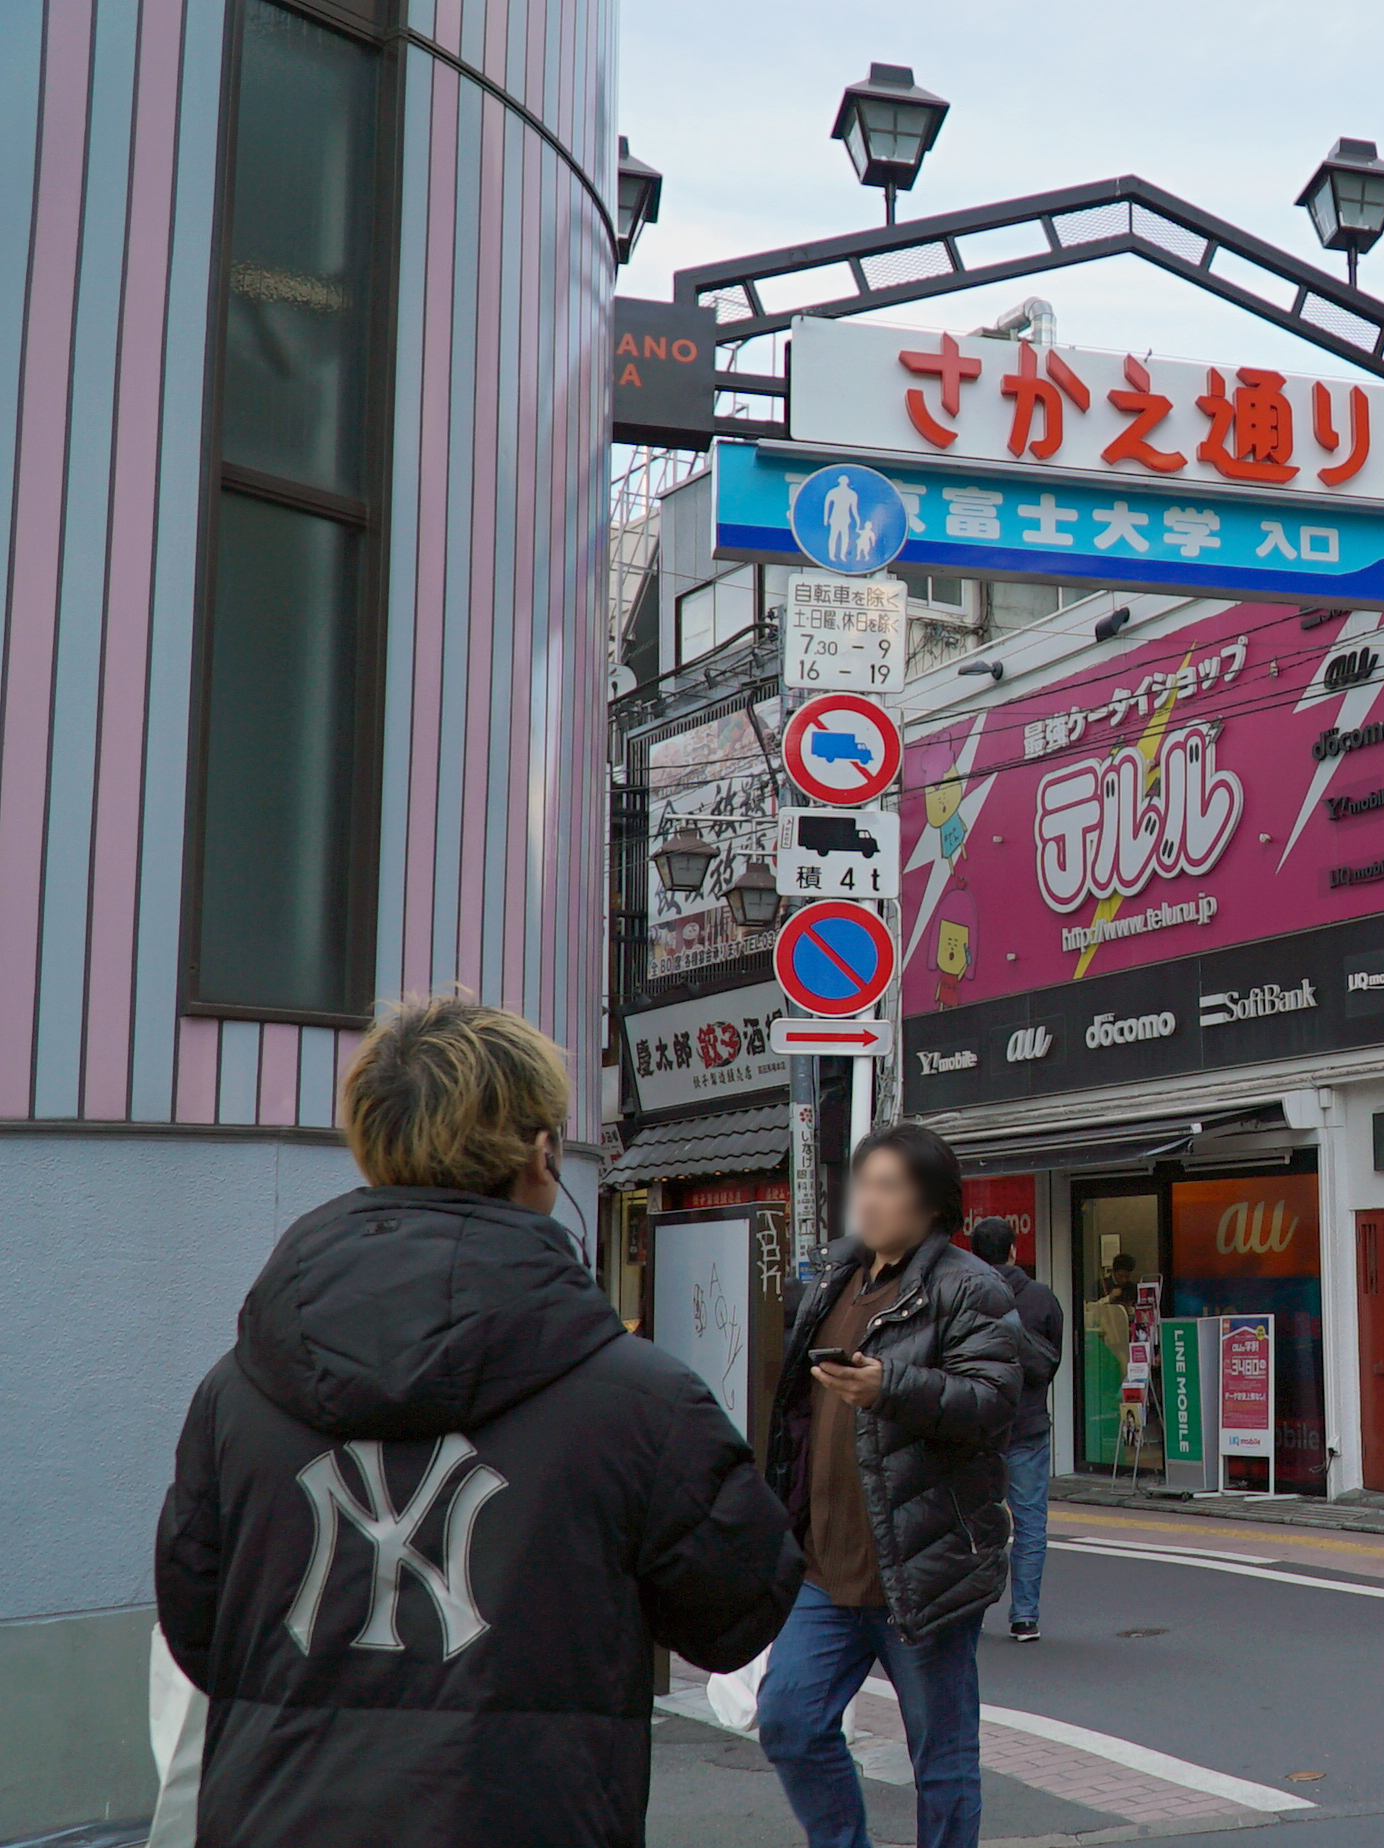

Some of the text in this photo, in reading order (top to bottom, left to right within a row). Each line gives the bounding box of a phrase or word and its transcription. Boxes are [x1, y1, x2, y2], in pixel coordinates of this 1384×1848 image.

[612, 362, 643, 388] A
[899, 332, 1370, 487] さかえ通り
[785, 473, 1340, 563] 富士大学 入口
[794, 582, 900, 609] 自転車を除く
[878, 638, 891, 660] 9
[1323, 646, 1379, 690] au
[799, 659, 820, 681] 16
[870, 663, 891, 685] 19
[1023, 635, 1249, 760] 最強ケータイショップ
[1034, 718, 1244, 914] テルル
[796, 865, 881, 892] 積 4 t
[1329, 866, 1352, 889] UQ
[1062, 892, 1218, 953] http://www.teluru.jp
[1224, 978, 1319, 1022] SoftBank
[1348, 972, 1369, 993] UQ
[1006, 1025, 1053, 1063] au
[1085, 1011, 1176, 1049] docomo
[916, 1049, 978, 1076] Y!mobile
[1215, 1199, 1300, 1255] au
[1173, 1329, 1190, 1453] LINE MOBILE
